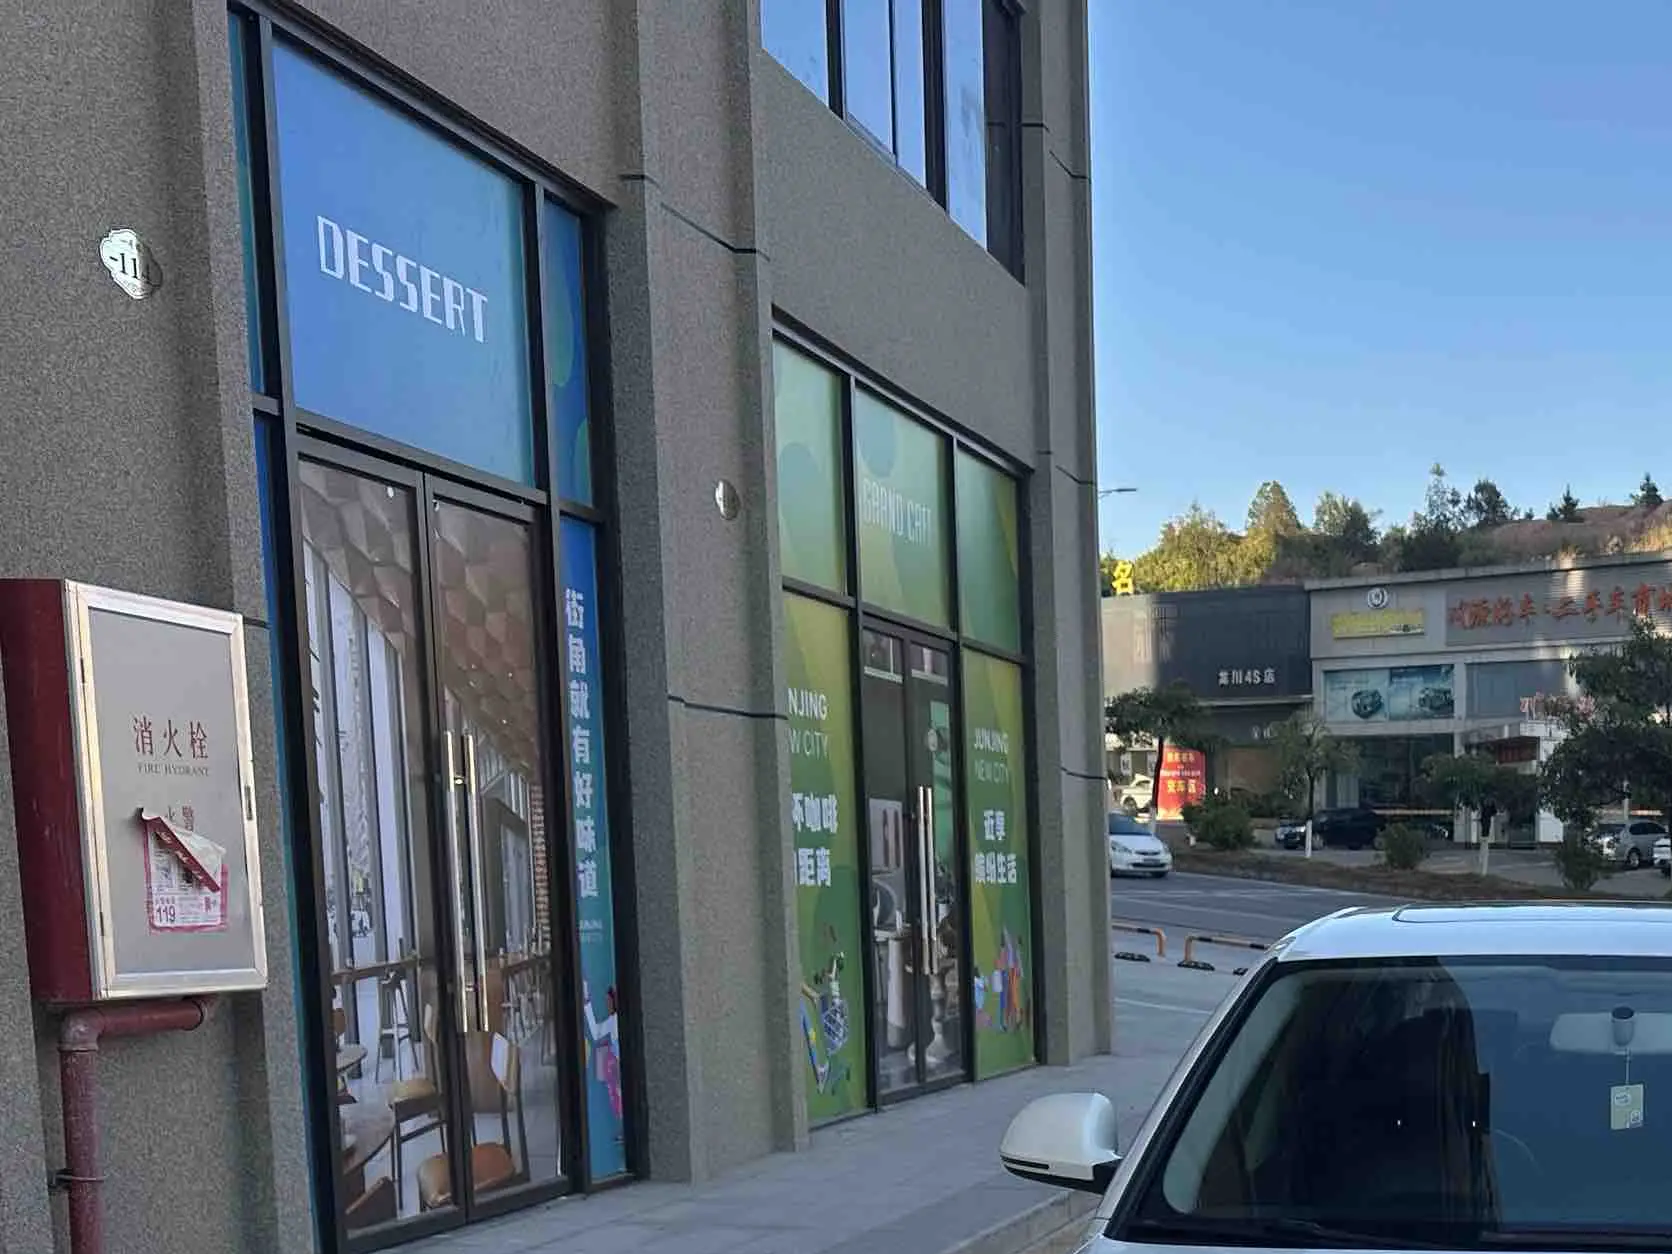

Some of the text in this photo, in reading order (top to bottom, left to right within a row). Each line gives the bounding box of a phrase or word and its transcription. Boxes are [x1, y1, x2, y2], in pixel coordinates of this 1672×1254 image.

[317, 215, 488, 343] DESSERT
[132, 715, 209, 759] 消火栓
[566, 587, 599, 898] 街角就有好味道
[794, 847, 832, 887] 距离
[155, 904, 176, 923] 119
